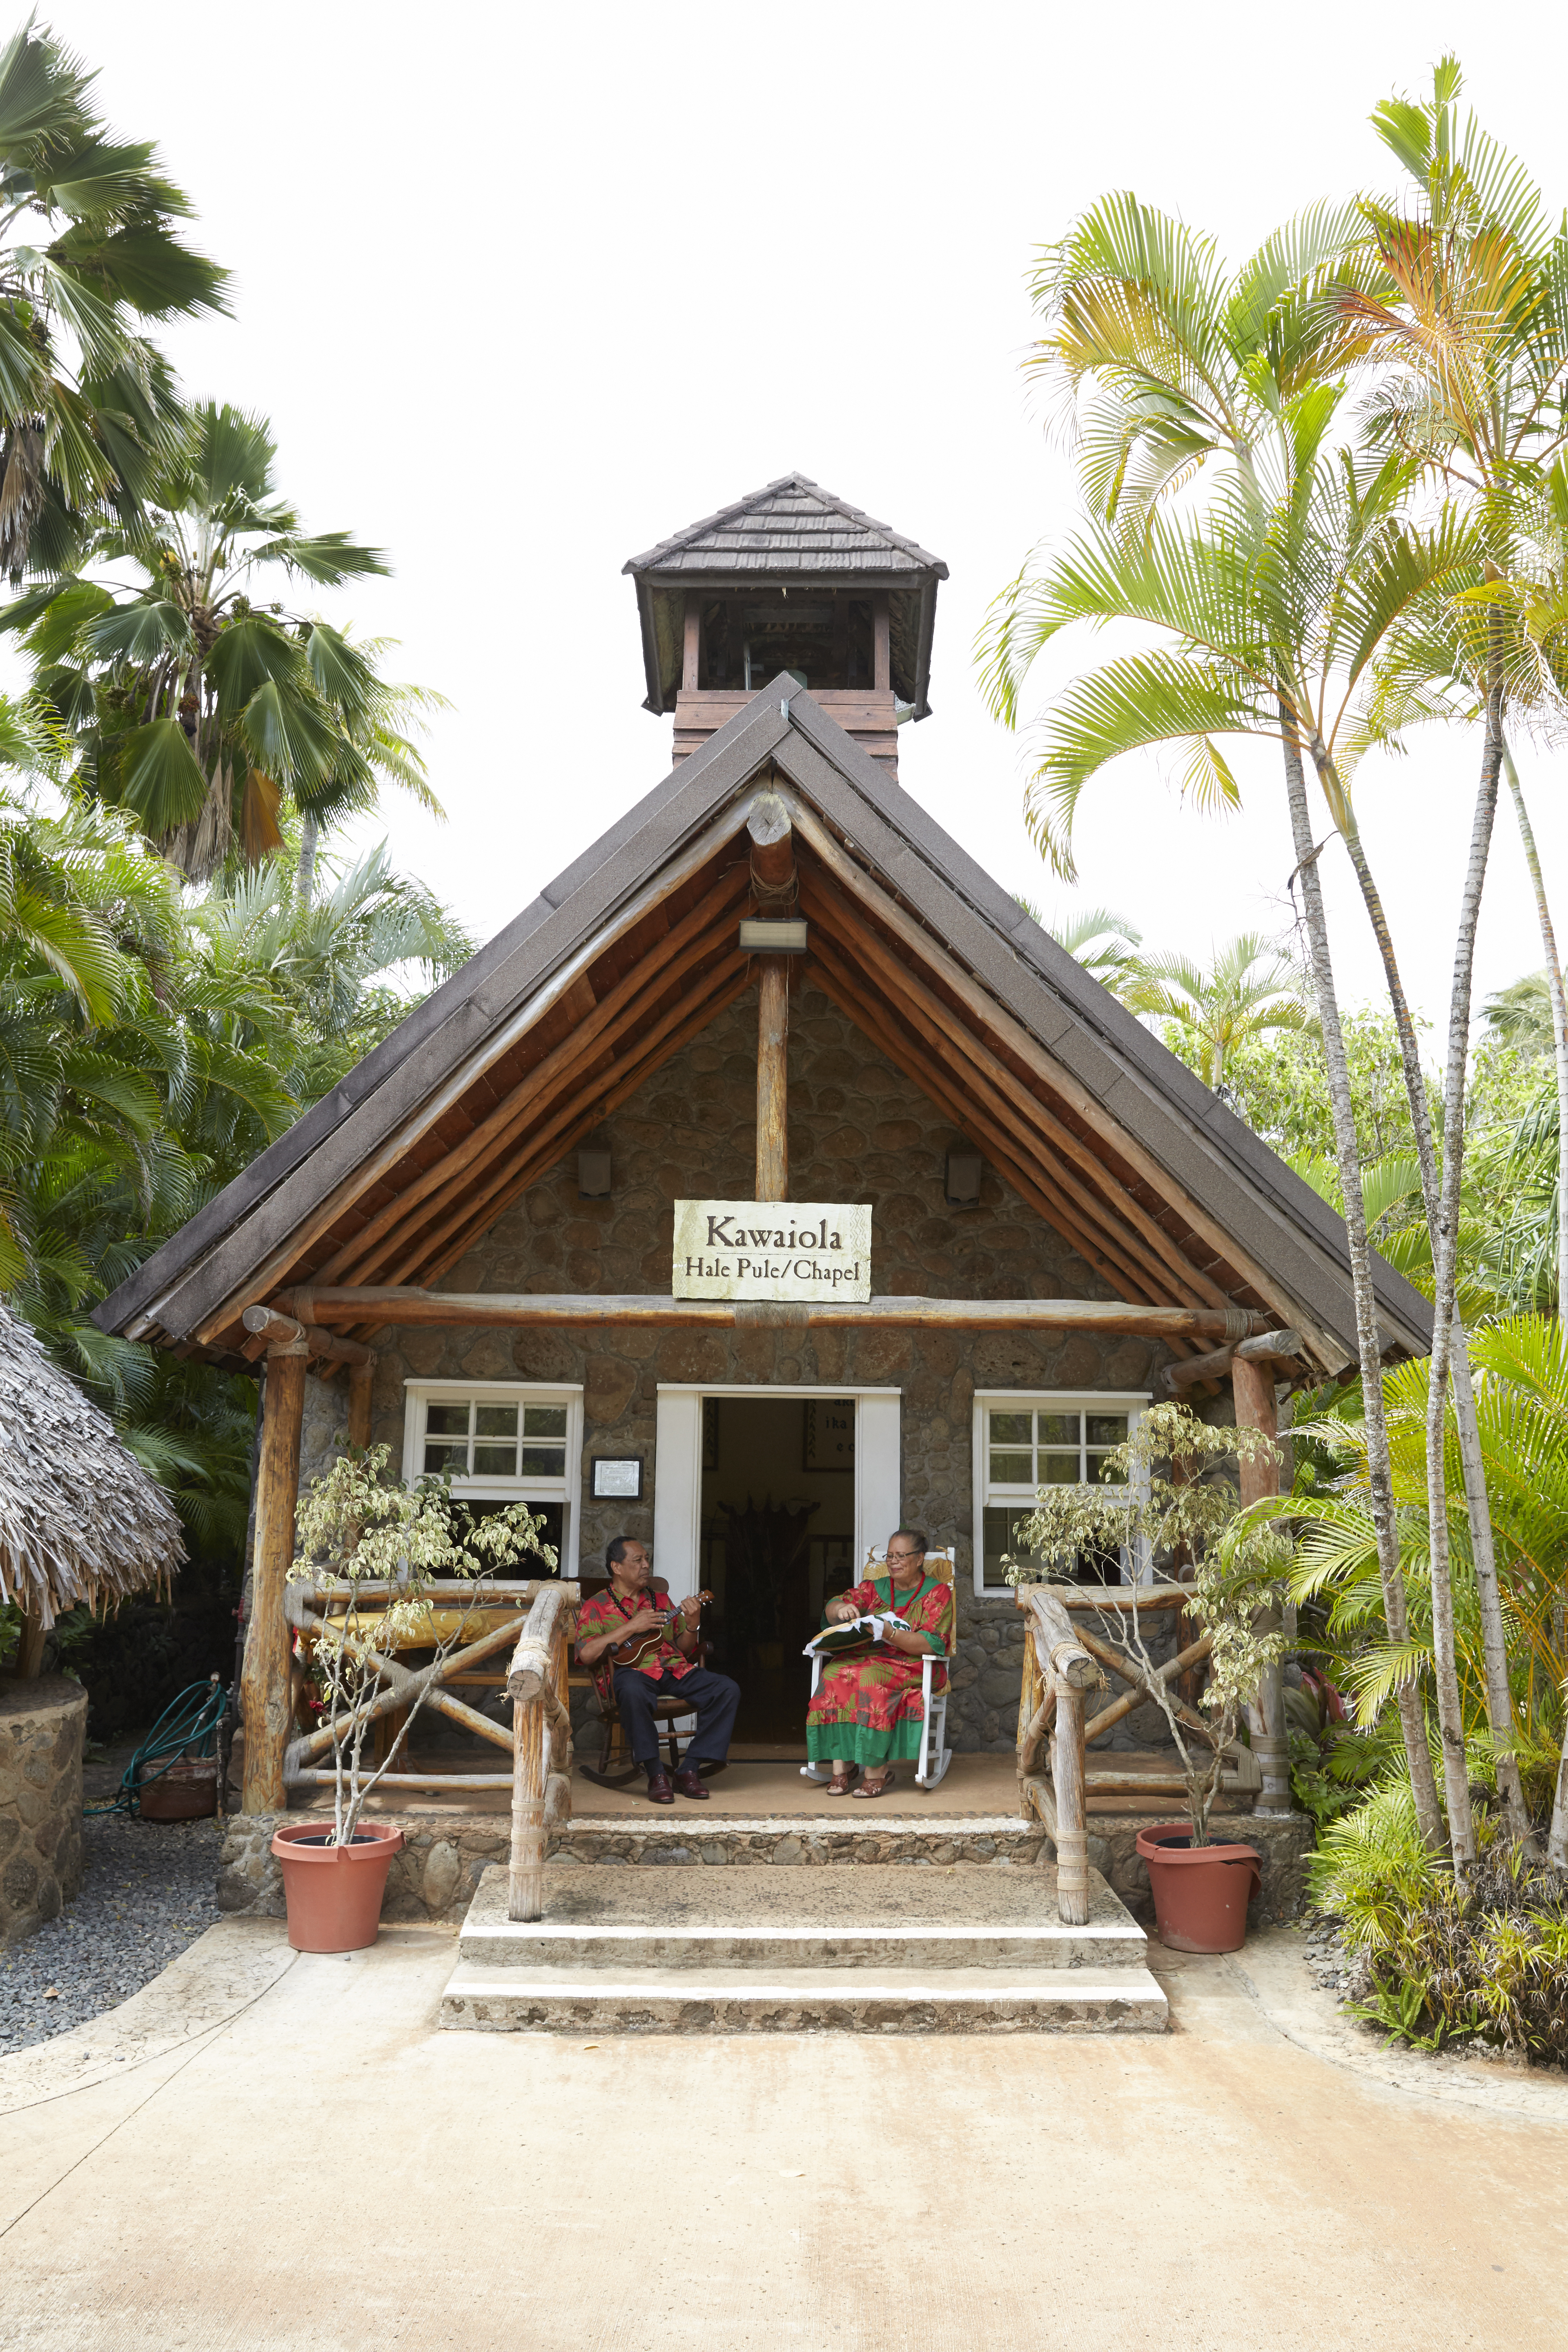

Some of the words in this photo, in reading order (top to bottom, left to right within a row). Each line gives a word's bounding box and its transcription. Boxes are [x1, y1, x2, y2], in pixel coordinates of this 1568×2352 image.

[706, 1215, 842, 1250] Kawaiola
[685, 1256, 731, 1277] Hale
[737, 1258, 860, 1287] Pule/Chapel
